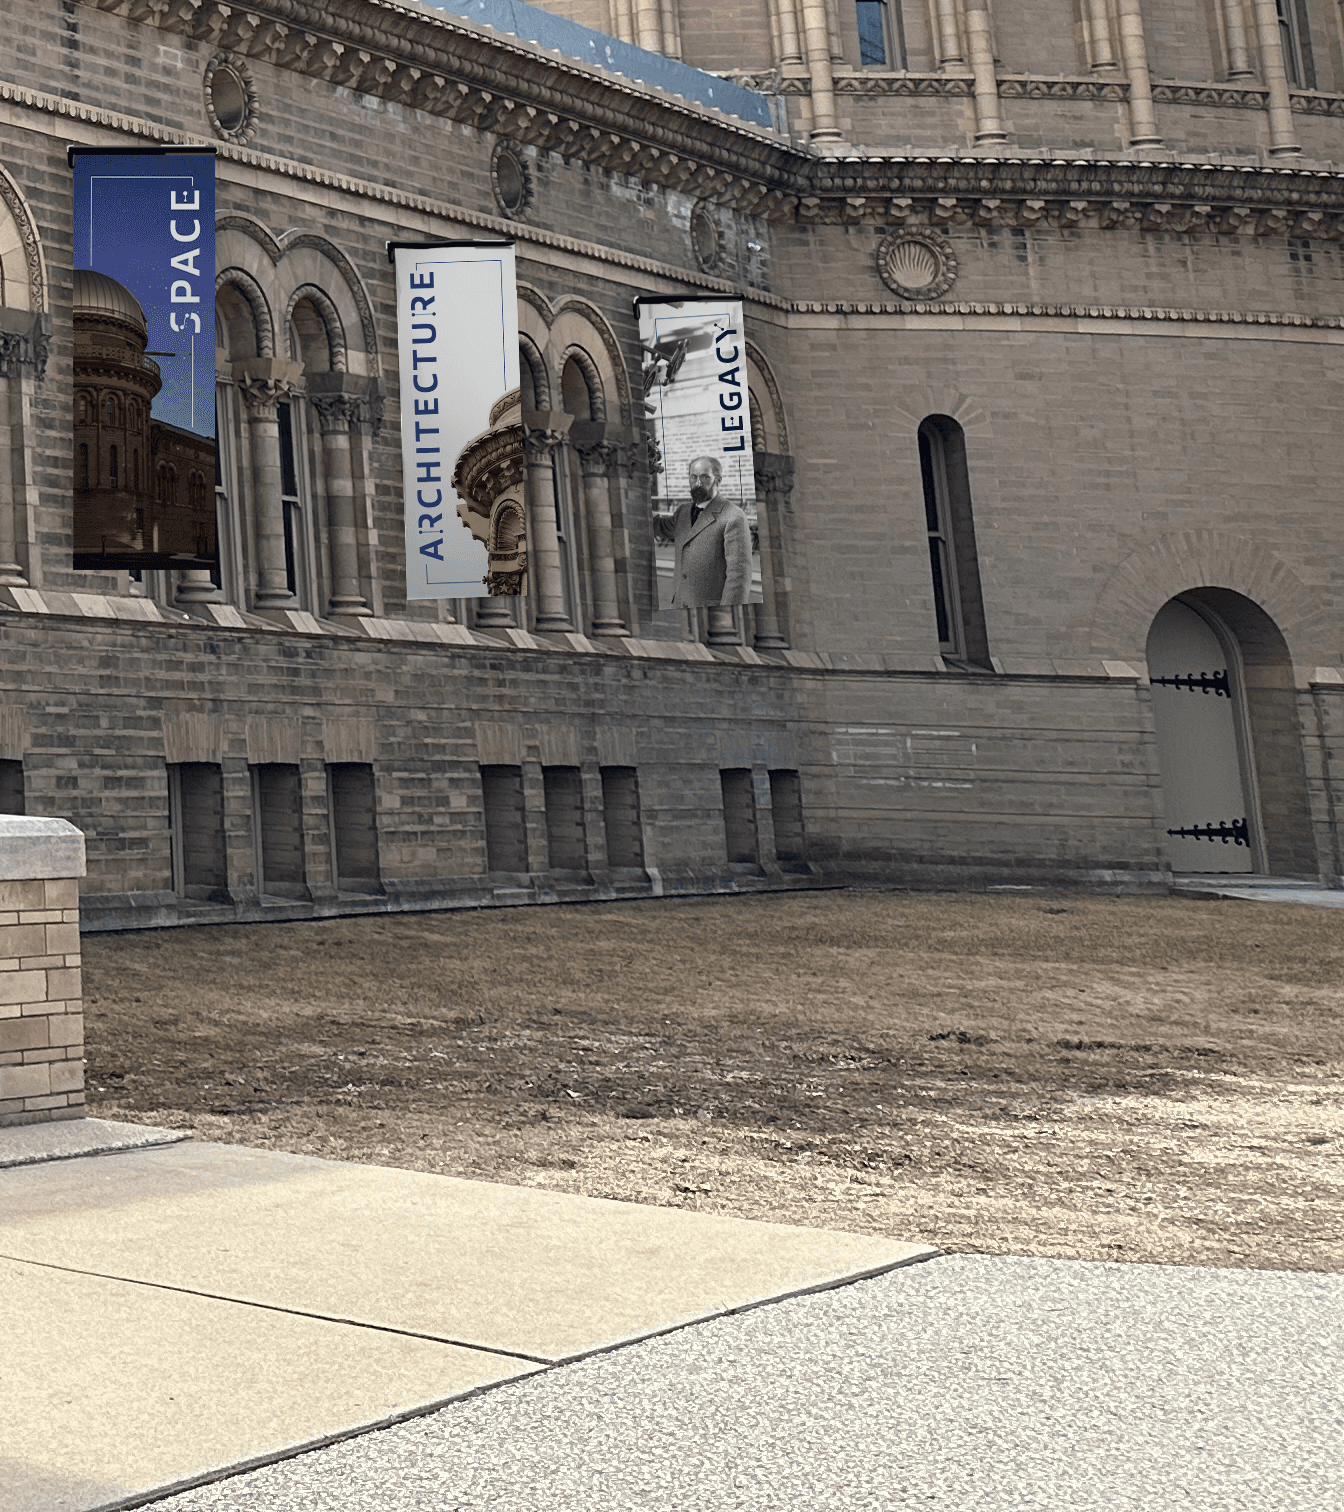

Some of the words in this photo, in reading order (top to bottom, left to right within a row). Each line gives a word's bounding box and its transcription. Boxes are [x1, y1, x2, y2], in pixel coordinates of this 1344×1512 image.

[170, 188, 201, 334] SPACE
[409, 270, 445, 562] ARCHITECTURE
[713, 322, 746, 453] LEGACY
